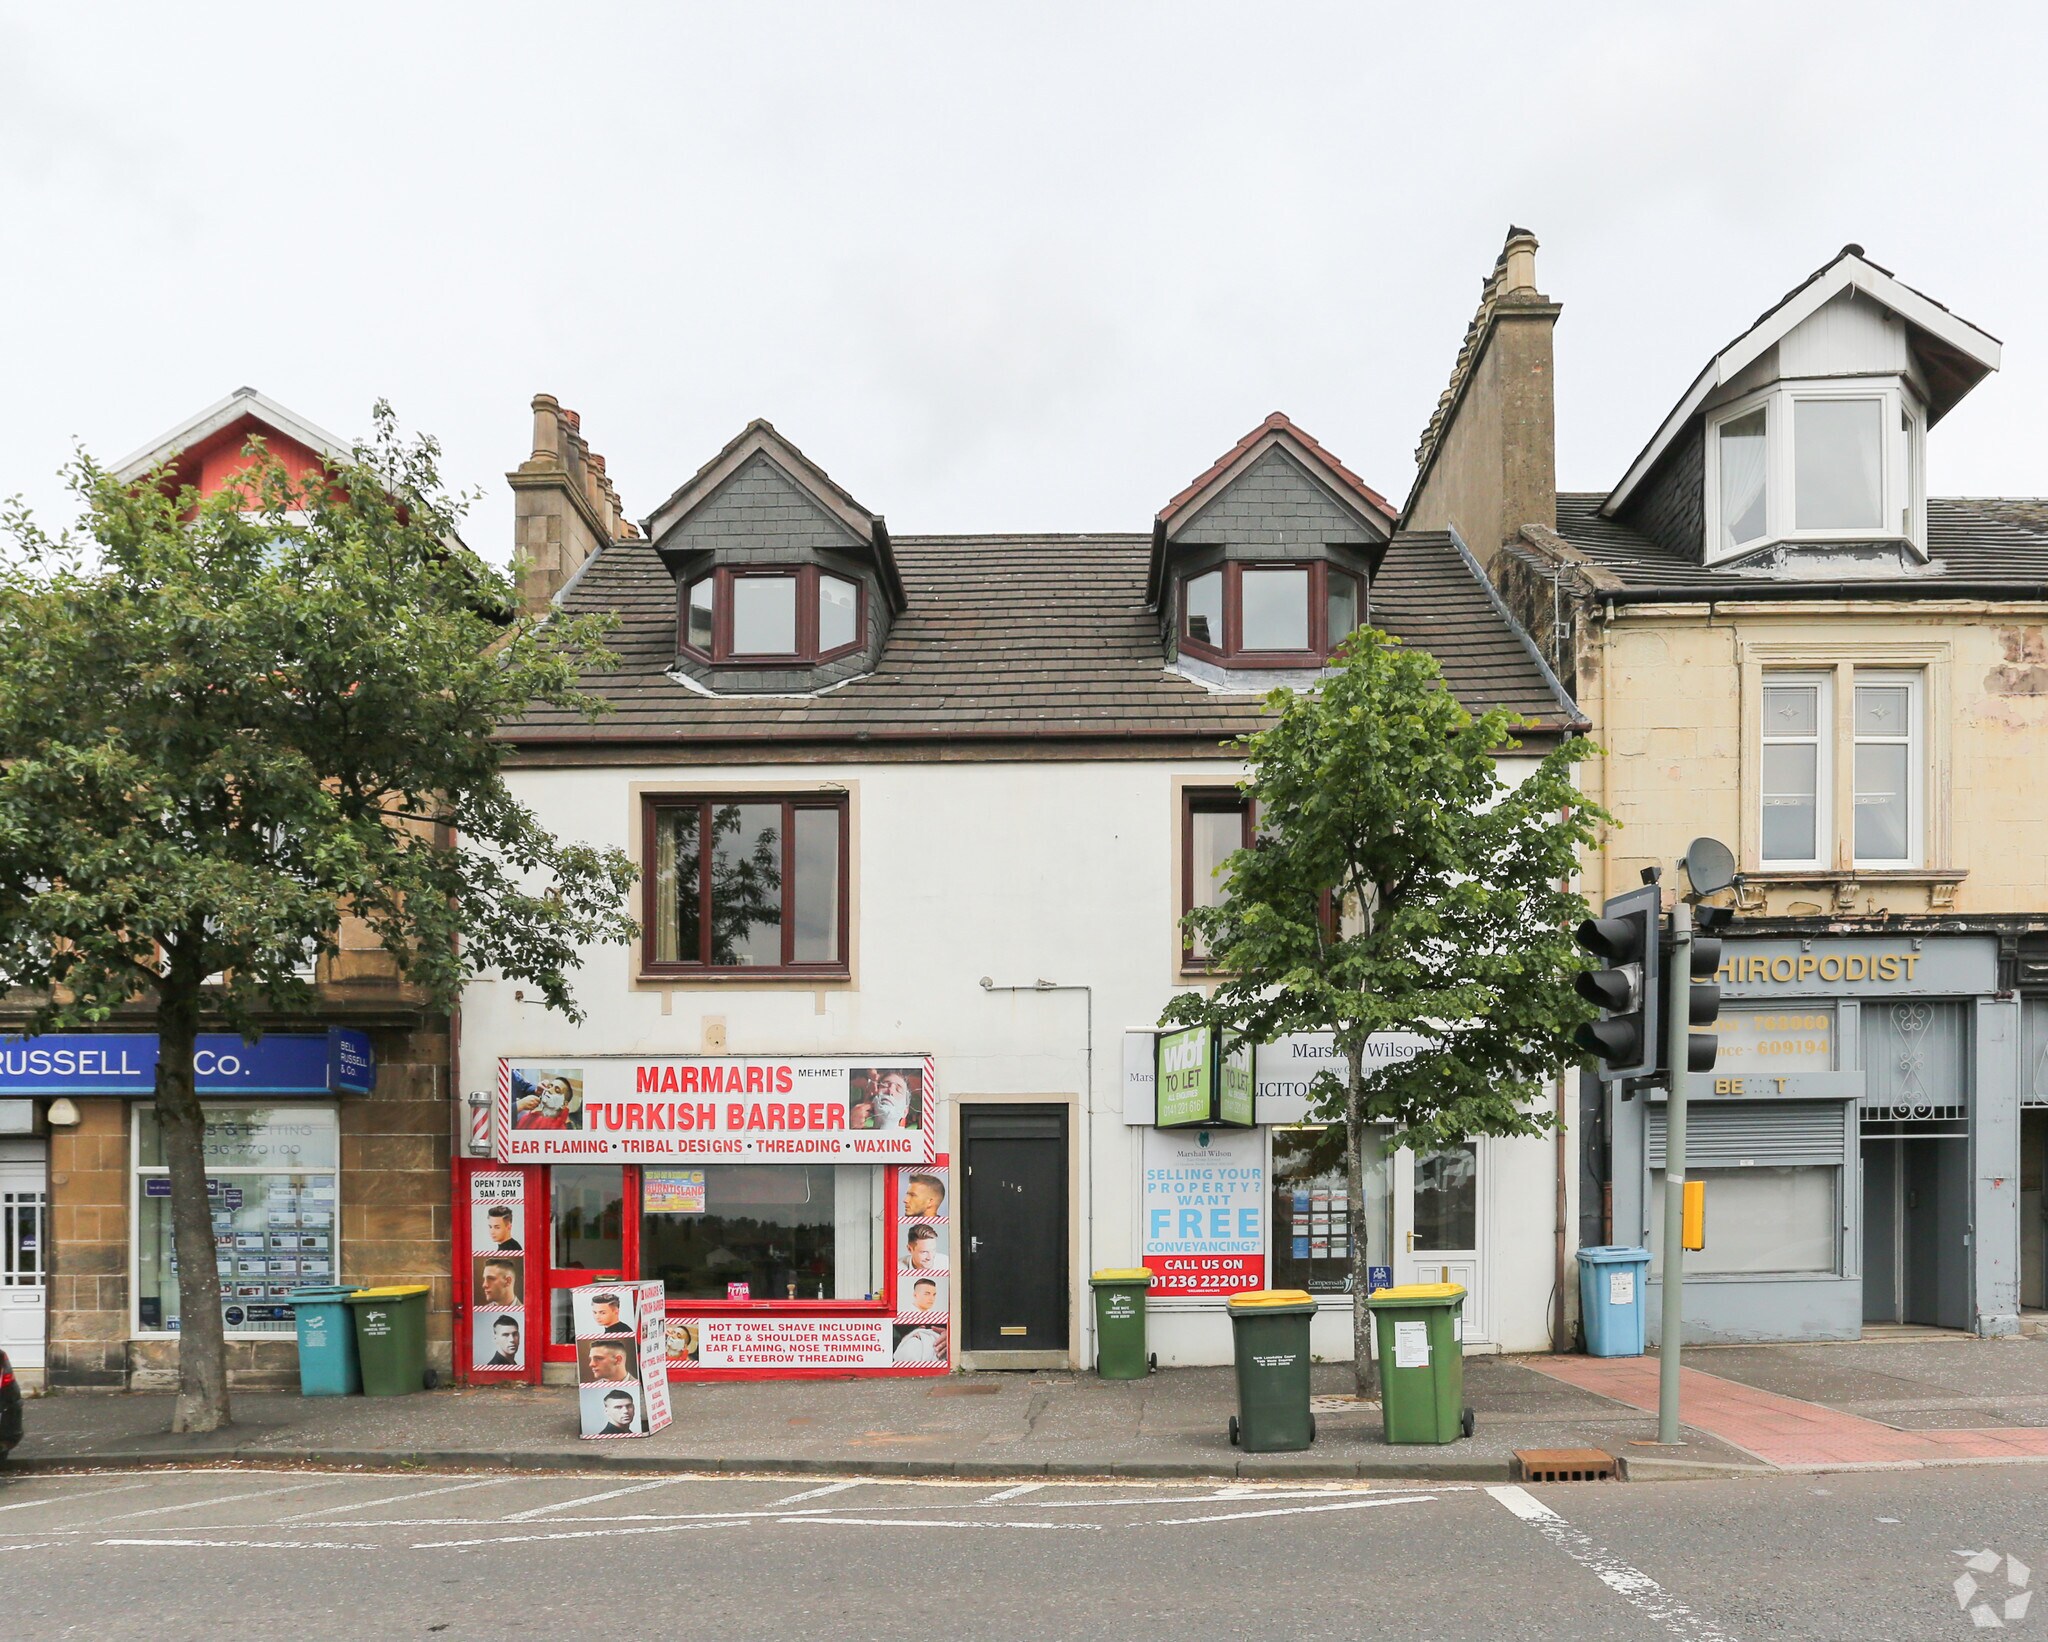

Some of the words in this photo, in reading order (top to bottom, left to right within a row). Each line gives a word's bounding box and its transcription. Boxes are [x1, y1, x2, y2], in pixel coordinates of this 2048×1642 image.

[1690, 954, 1922, 983] HIROPODIST
[340, 1040, 356, 1053] BELL
[1292, 1043, 1349, 1058] Mars
[1367, 1042, 1424, 1057] Wilson
[1757, 1040, 1829, 1056] 609194
[0, 1050, 141, 1075] USSELL
[340, 1052, 368, 1067] RUSSELL
[636, 1066, 793, 1094] MARMARIS
[798, 1069, 845, 1078] MEHMET
[1129, 1073, 1154, 1082] Mars
[1166, 1074, 1179, 1092] TO
[1182, 1069, 1201, 1089] LET
[1225, 1069, 1235, 1088] TO
[1237, 1073, 1249, 1092] LET
[586, 1102, 716, 1131] TURKISH
[727, 1103, 846, 1131] BARBER
[203, 1145, 230, 1155] 236
[511, 1140, 540, 1154] EAR
[544, 1140, 609, 1154] FLAMING
[621, 1139, 674, 1153] TRIBAL
[678, 1139, 743, 1153] DESIGNS
[756, 1139, 841, 1153] THREADING
[854, 1138, 912, 1153] WAXING
[1208, 1149, 1232, 1157] Wilson
[1147, 1169, 1213, 1181] SELLING
[1217, 1168, 1261, 1180] YOUR
[474, 1179, 495, 1188] OPEN
[502, 1179, 522, 1188] DAYS
[645, 1183, 705, 1197] BURNTISLAND
[1148, 1182, 1261, 1194] PROPERTY?
[480, 1190, 496, 1198] 9AM
[501, 1190, 516, 1198] 6PM
[1177, 1195, 1231, 1206] WANT
[1150, 1208, 1260, 1239] FREE
[213, 1236, 232, 1244] OLD
[1164, 1259, 1199, 1270] CALL
[1201, 1259, 1220, 1270] US
[1223, 1259, 1243, 1270] ON
[1150, 1275, 1198, 1288] 01236
[1200, 1274, 1259, 1287] 222019
[1308, 1278, 1345, 1287] Compensate
[708, 1323, 732, 1332] HOT
[736, 1323, 775, 1332] TOWEL
[779, 1323, 816, 1332] SHAVE
[819, 1323, 882, 1332] INCLUDING
[710, 1333, 742, 1342] HEAD
[745, 1333, 753, 1342] &
[757, 1333, 818, 1342] SHOULDER
[822, 1333, 880, 1343] MASSAGE,
[706, 1344, 728, 1352] EAR
[732, 1344, 786, 1353] FLAMING,
[789, 1344, 820, 1352] NOSE
[824, 1344, 885, 1353] TRIMMING,
[727, 1355, 735, 1363] &
[739, 1354, 795, 1363] EYEBROW
[799, 1354, 864, 1363] THREADING
